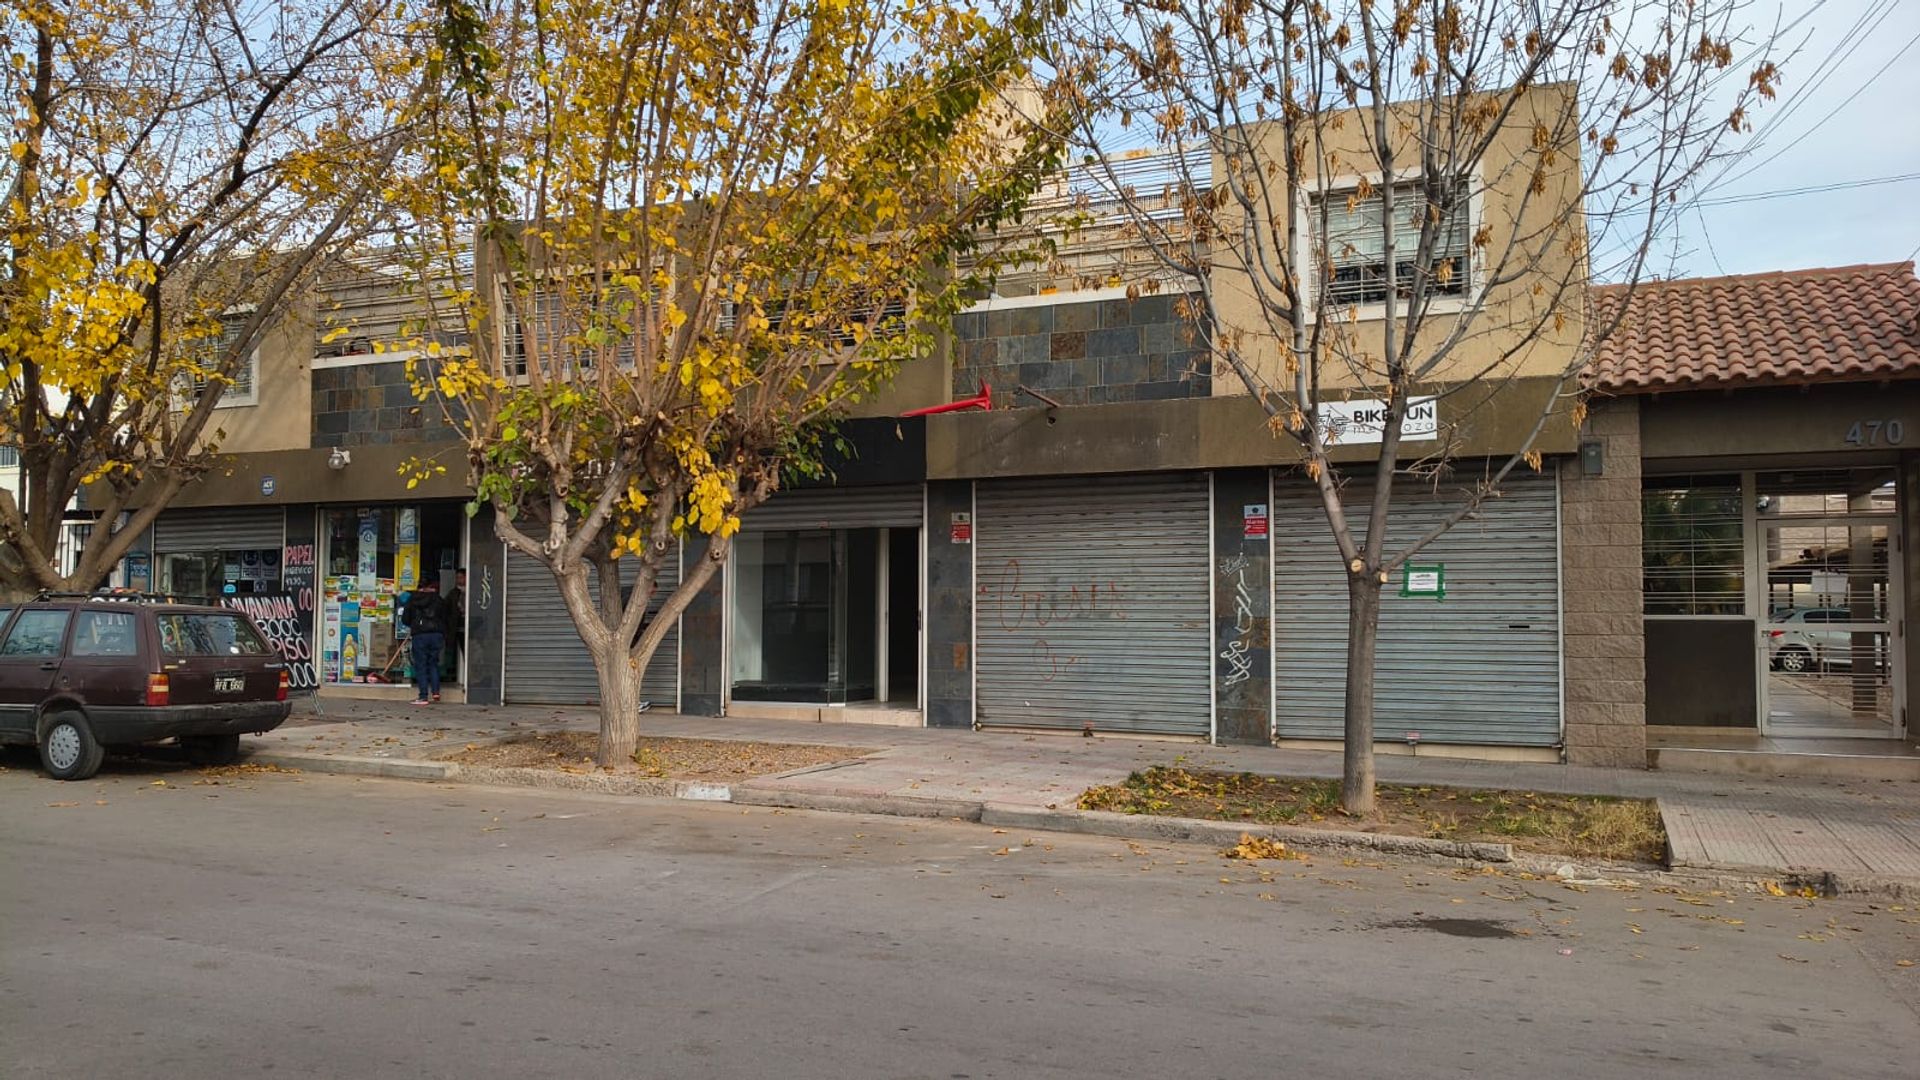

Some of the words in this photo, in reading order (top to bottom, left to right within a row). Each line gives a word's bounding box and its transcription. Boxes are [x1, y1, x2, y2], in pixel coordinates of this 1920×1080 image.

[1402, 407, 1433, 420] UN
[1846, 420, 1904, 446] 470
[285, 544, 314, 565] PAPEL
